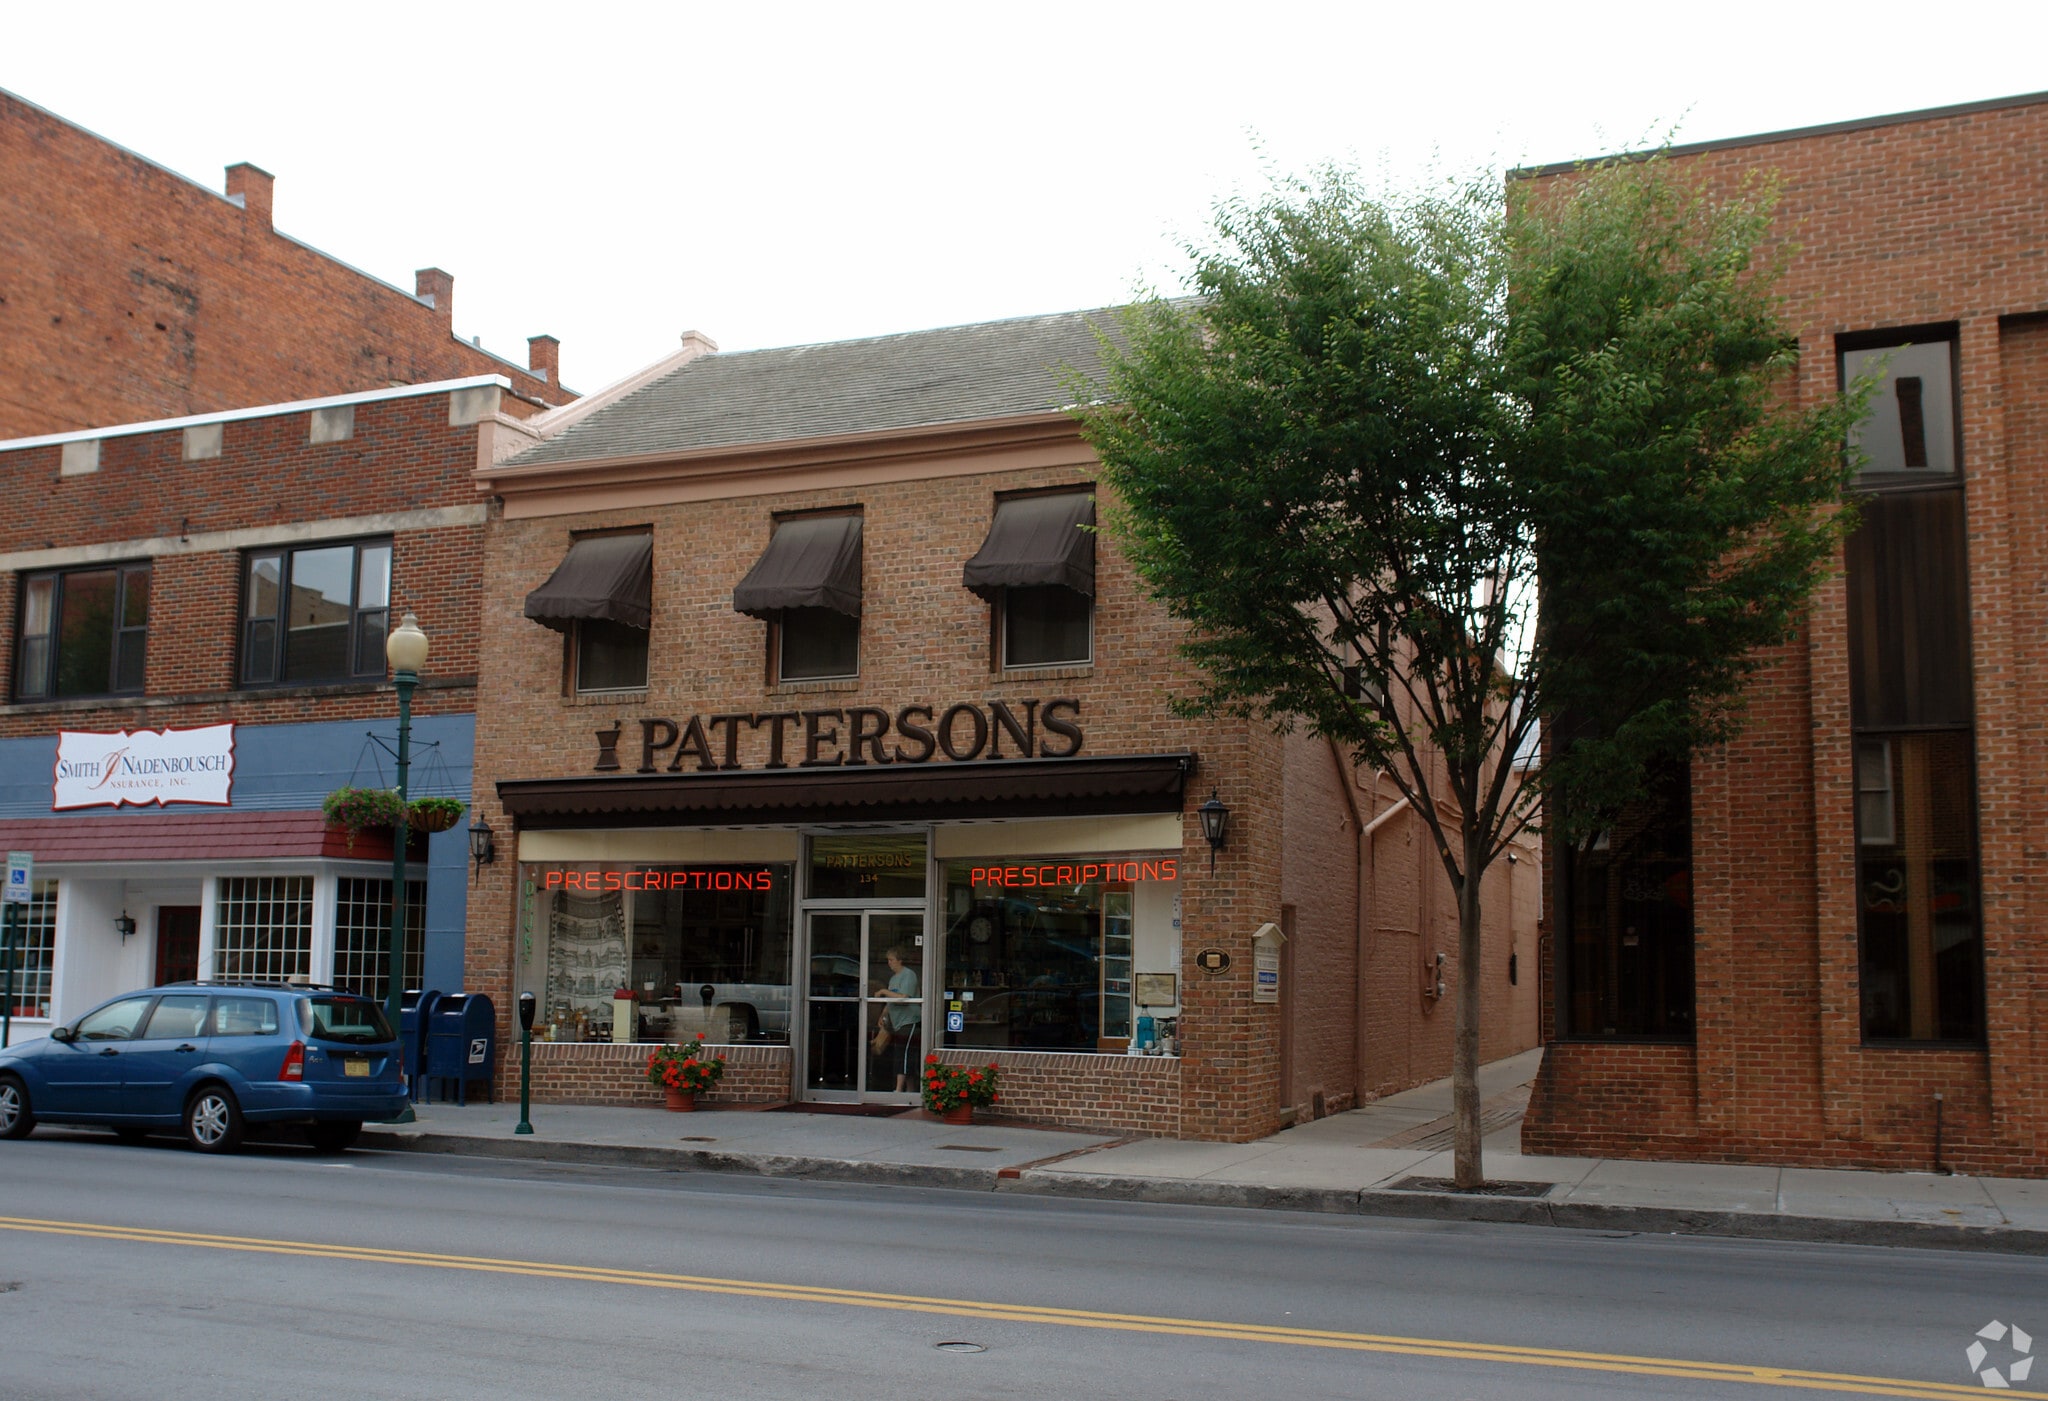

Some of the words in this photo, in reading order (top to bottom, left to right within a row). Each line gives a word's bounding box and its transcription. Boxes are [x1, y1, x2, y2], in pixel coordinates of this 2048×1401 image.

[637, 699, 1083, 773] PATTERSONS
[59, 759, 100, 779] SMITH
[121, 755, 225, 776] NADENBOUSCH
[170, 777, 191, 787] INC.
[545, 871, 773, 891] PRESCRIPTIONS
[860, 873, 878, 884] 134
[971, 861, 1177, 887] PRESCRIPTIONS
